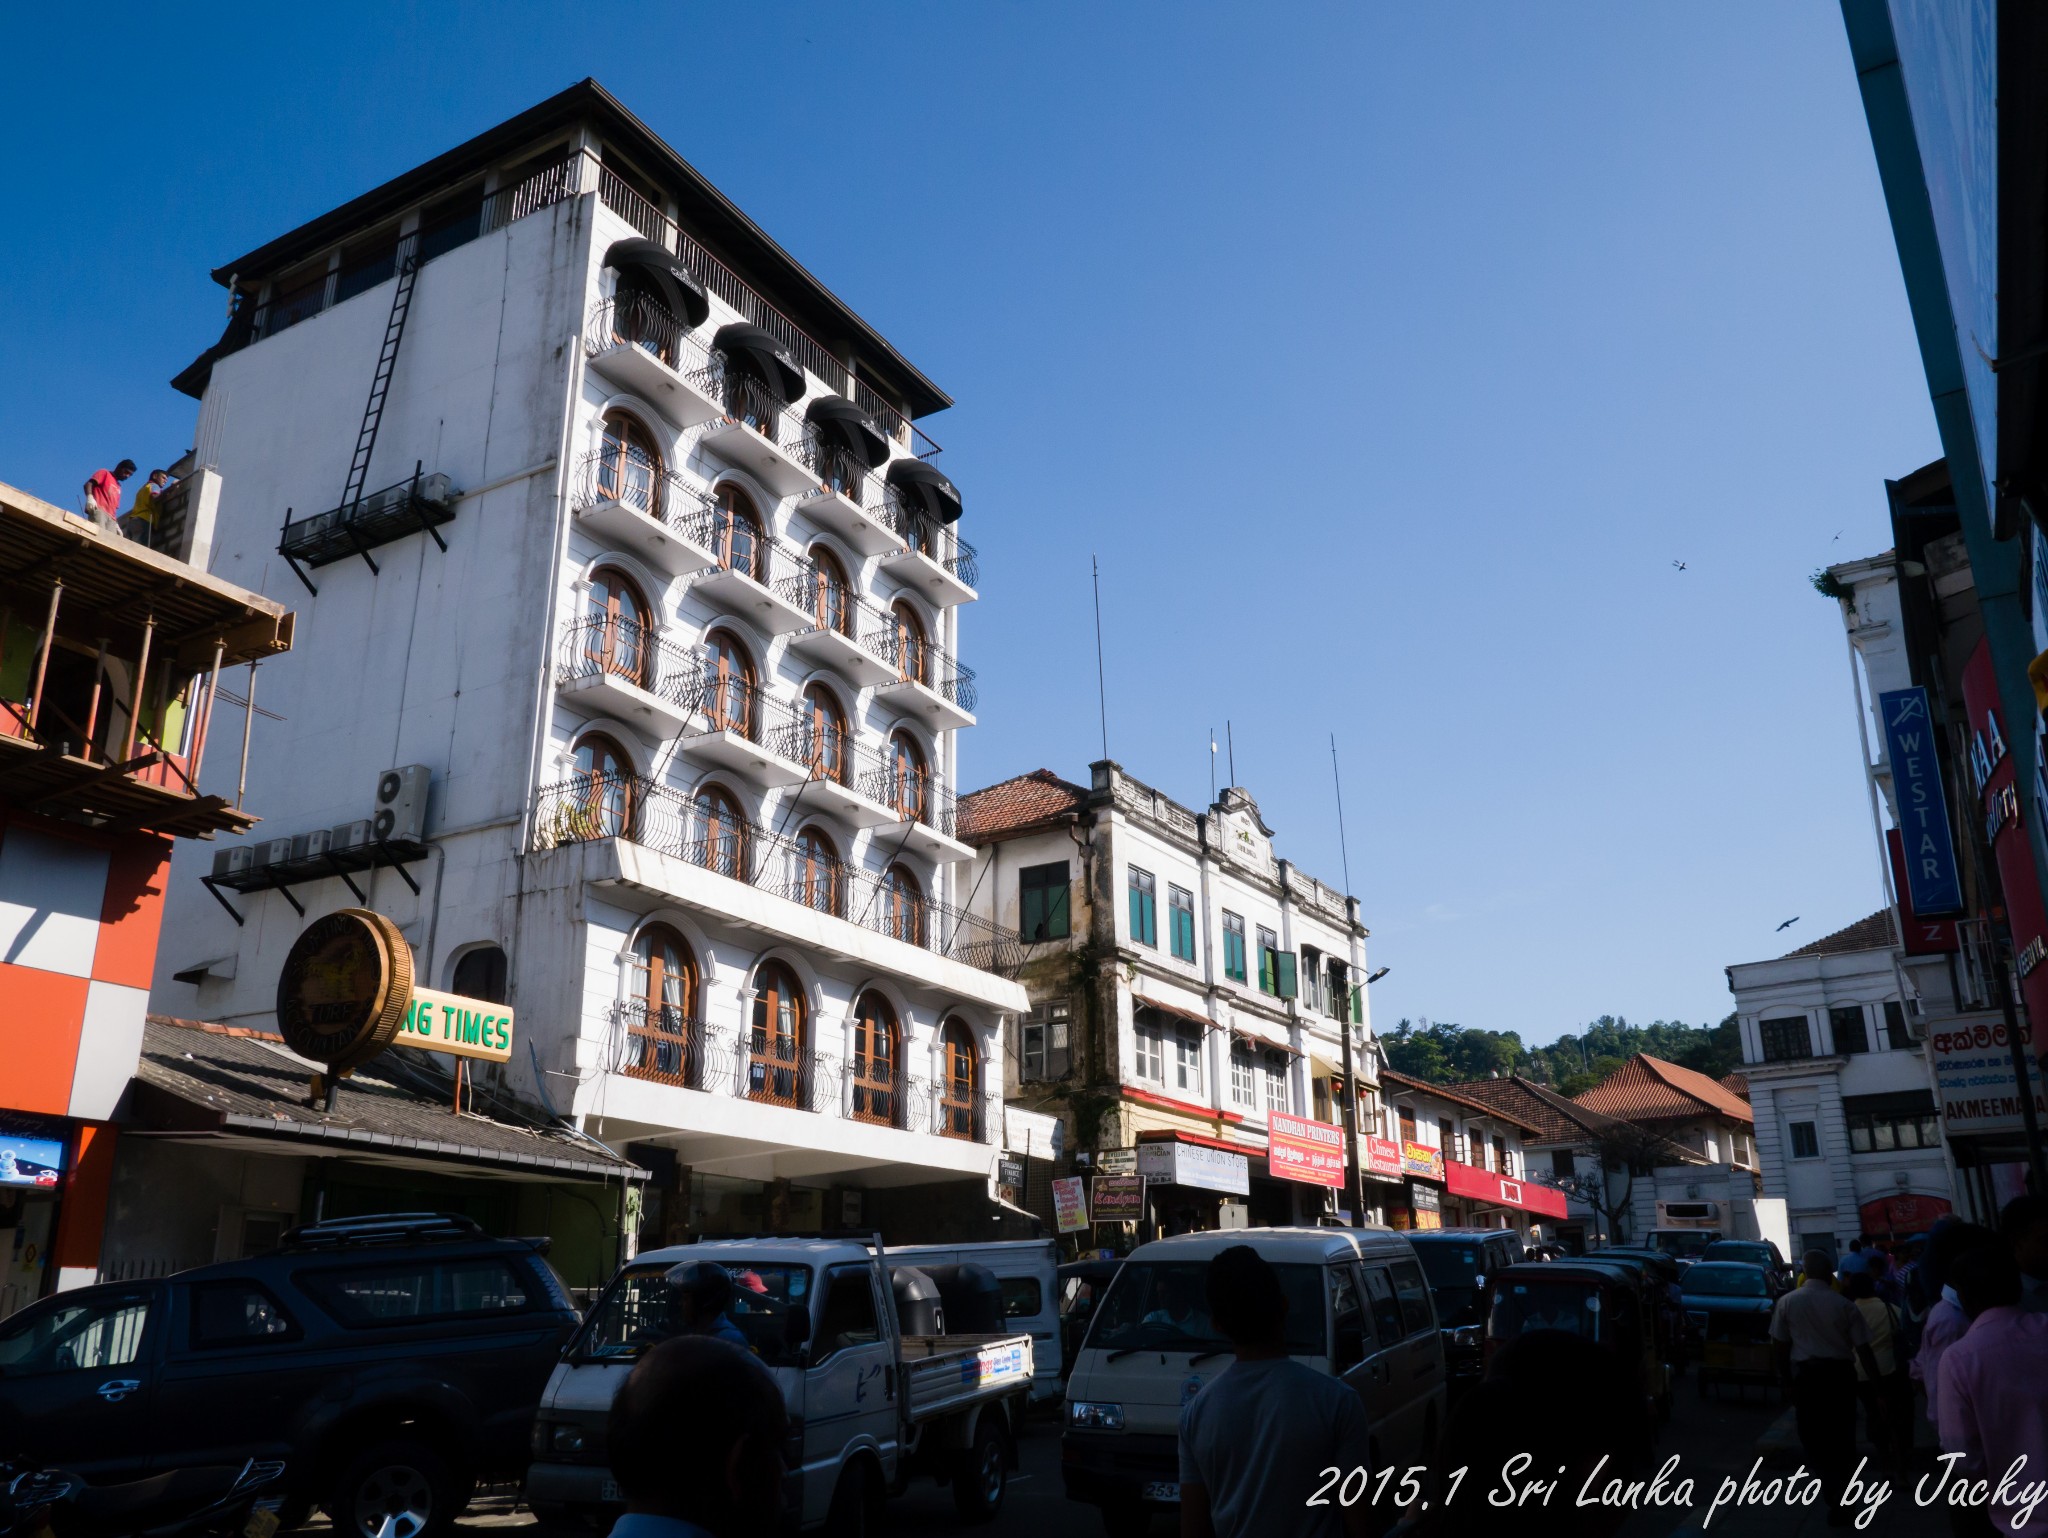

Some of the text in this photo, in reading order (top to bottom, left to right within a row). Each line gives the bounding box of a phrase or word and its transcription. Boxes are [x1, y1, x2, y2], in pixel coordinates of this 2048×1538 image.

[1897, 731, 1940, 880] WESTAR
[442, 1005, 510, 1050] TIMES
[1946, 1095, 2046, 1120] AKMEEMAA
[1272, 1115, 1306, 1138] NANDHAN
[1307, 1124, 1340, 1146] PRINTERS
[1176, 1145, 1247, 1170] CHINESE UNION STORE
[1370, 1138, 1396, 1159] Chinese
[1094, 1192, 1141, 1207] Kandyan
